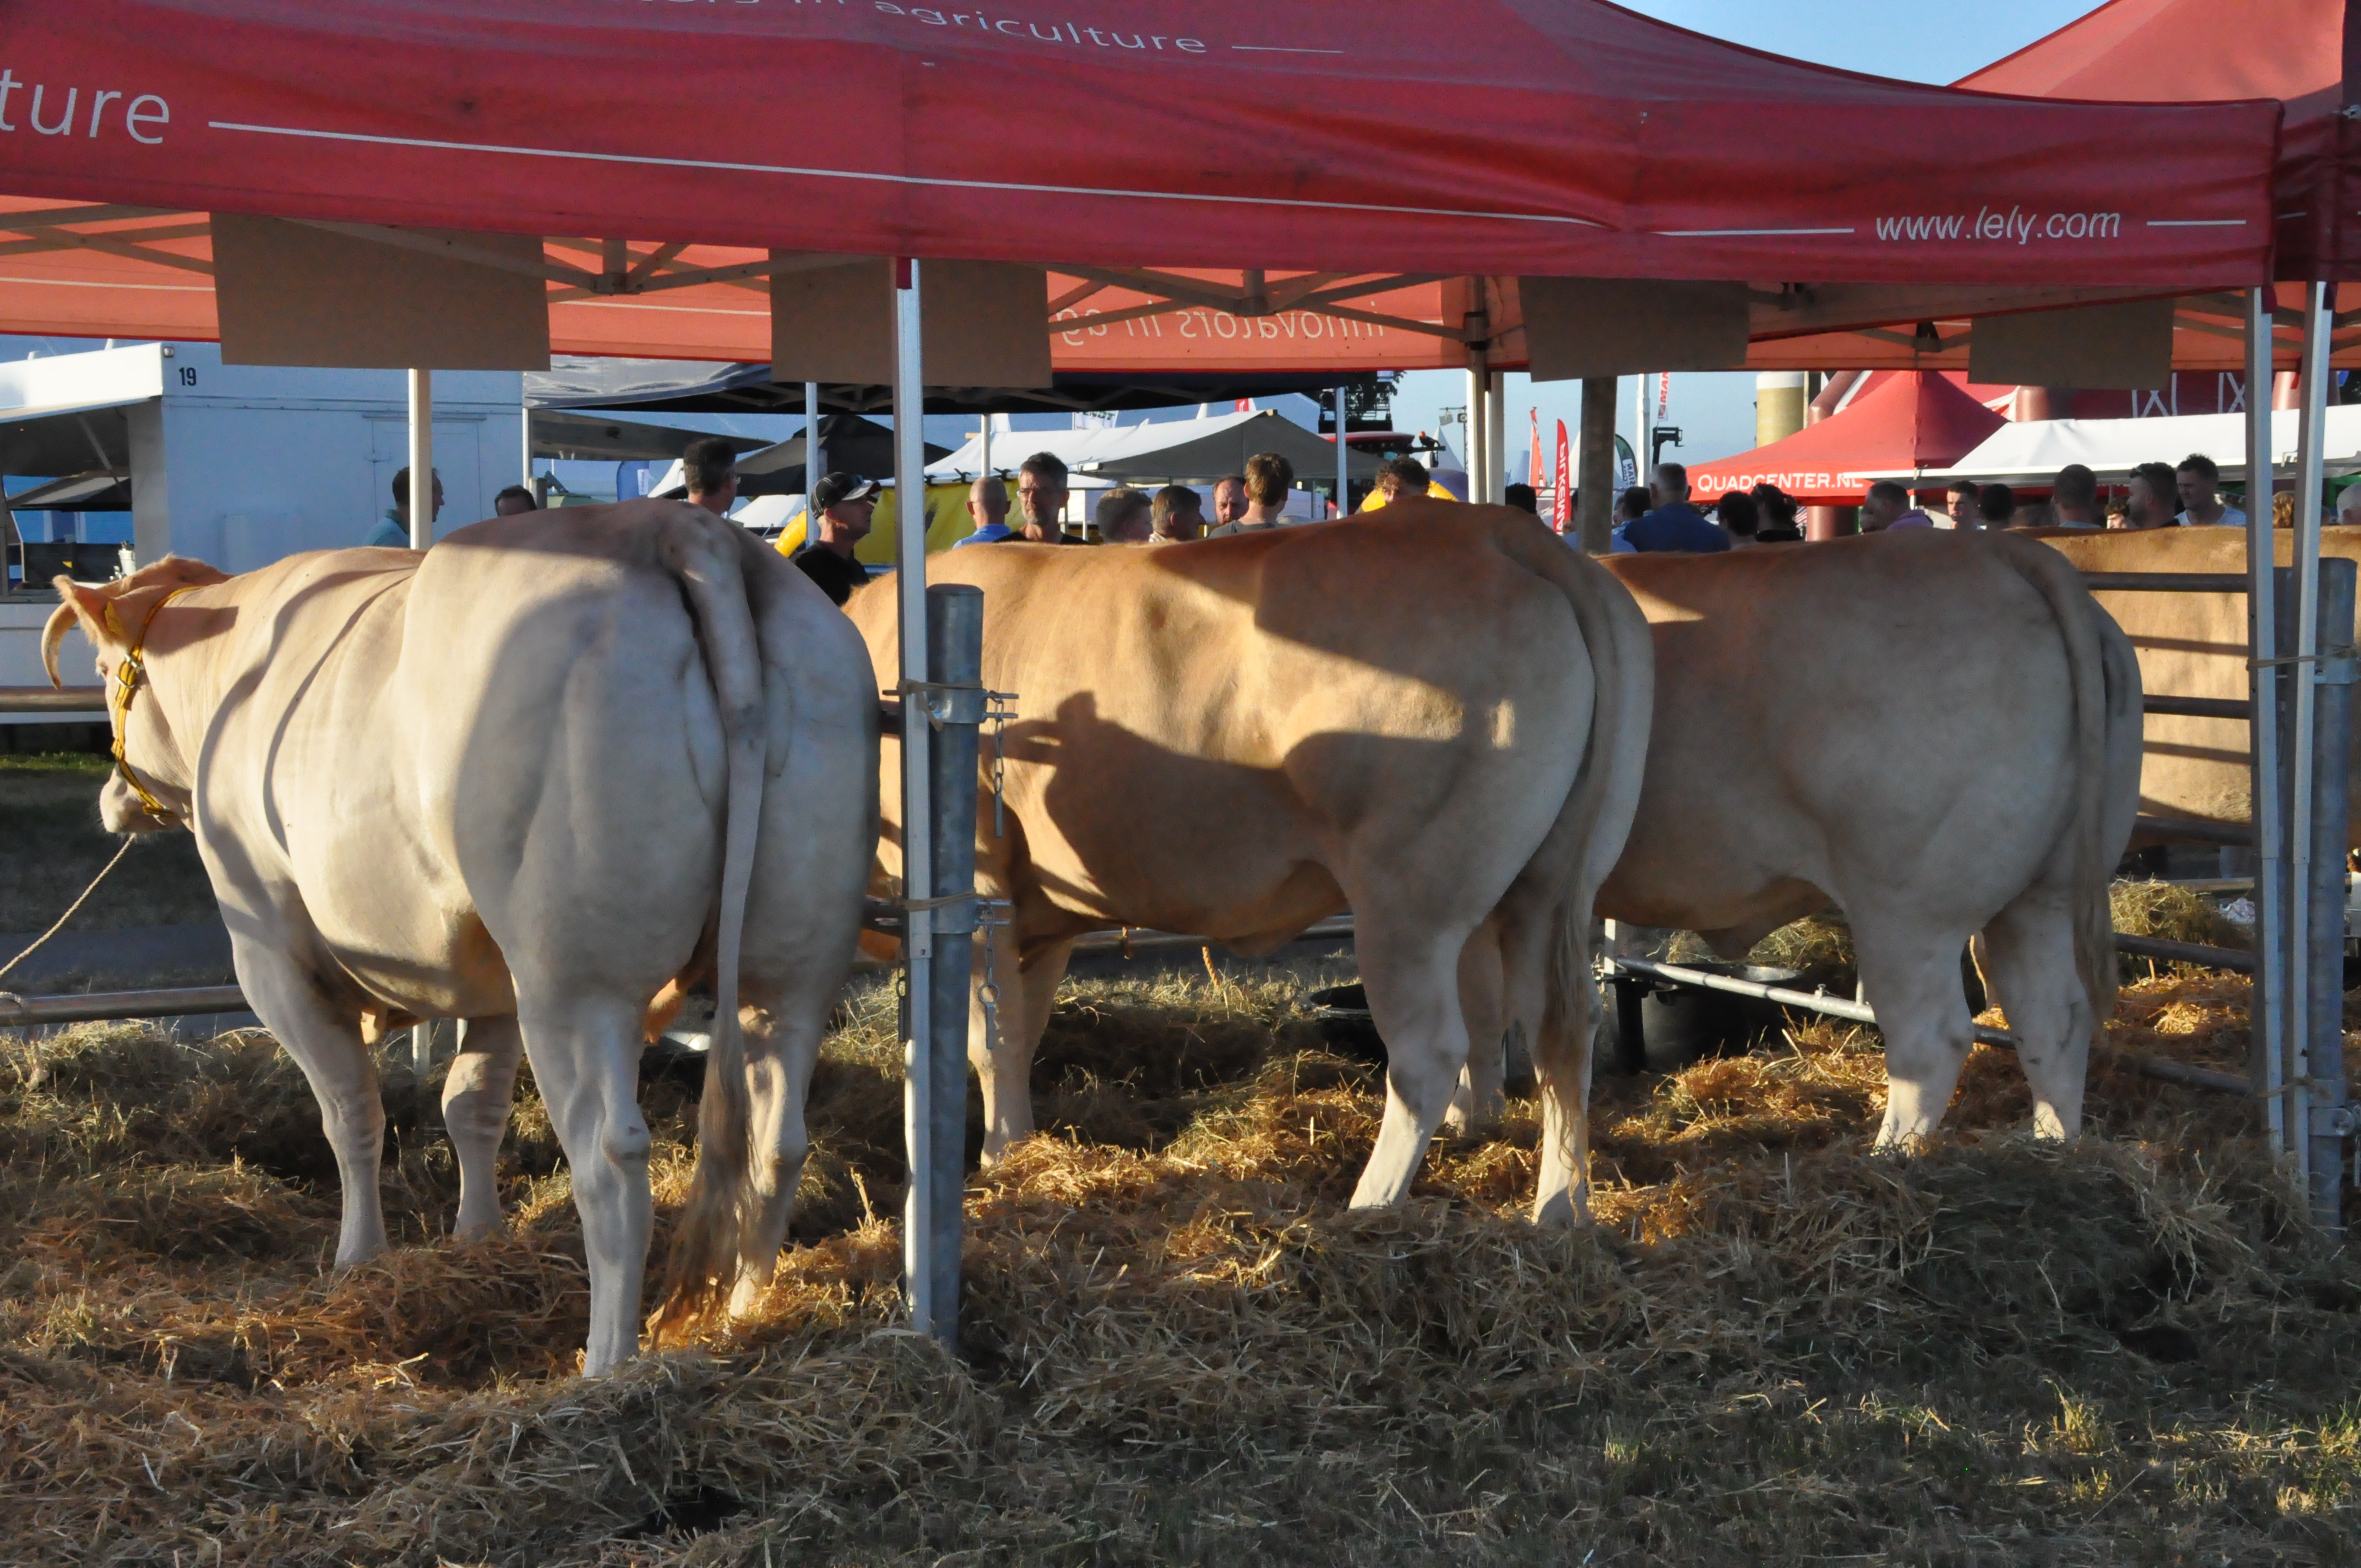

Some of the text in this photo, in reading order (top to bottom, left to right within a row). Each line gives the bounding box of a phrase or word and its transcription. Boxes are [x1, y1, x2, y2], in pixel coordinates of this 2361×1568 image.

[874, 1, 1206, 53] agriculture
[1876, 205, 2120, 245] www.lely.com
[179, 367, 197, 386] 19
